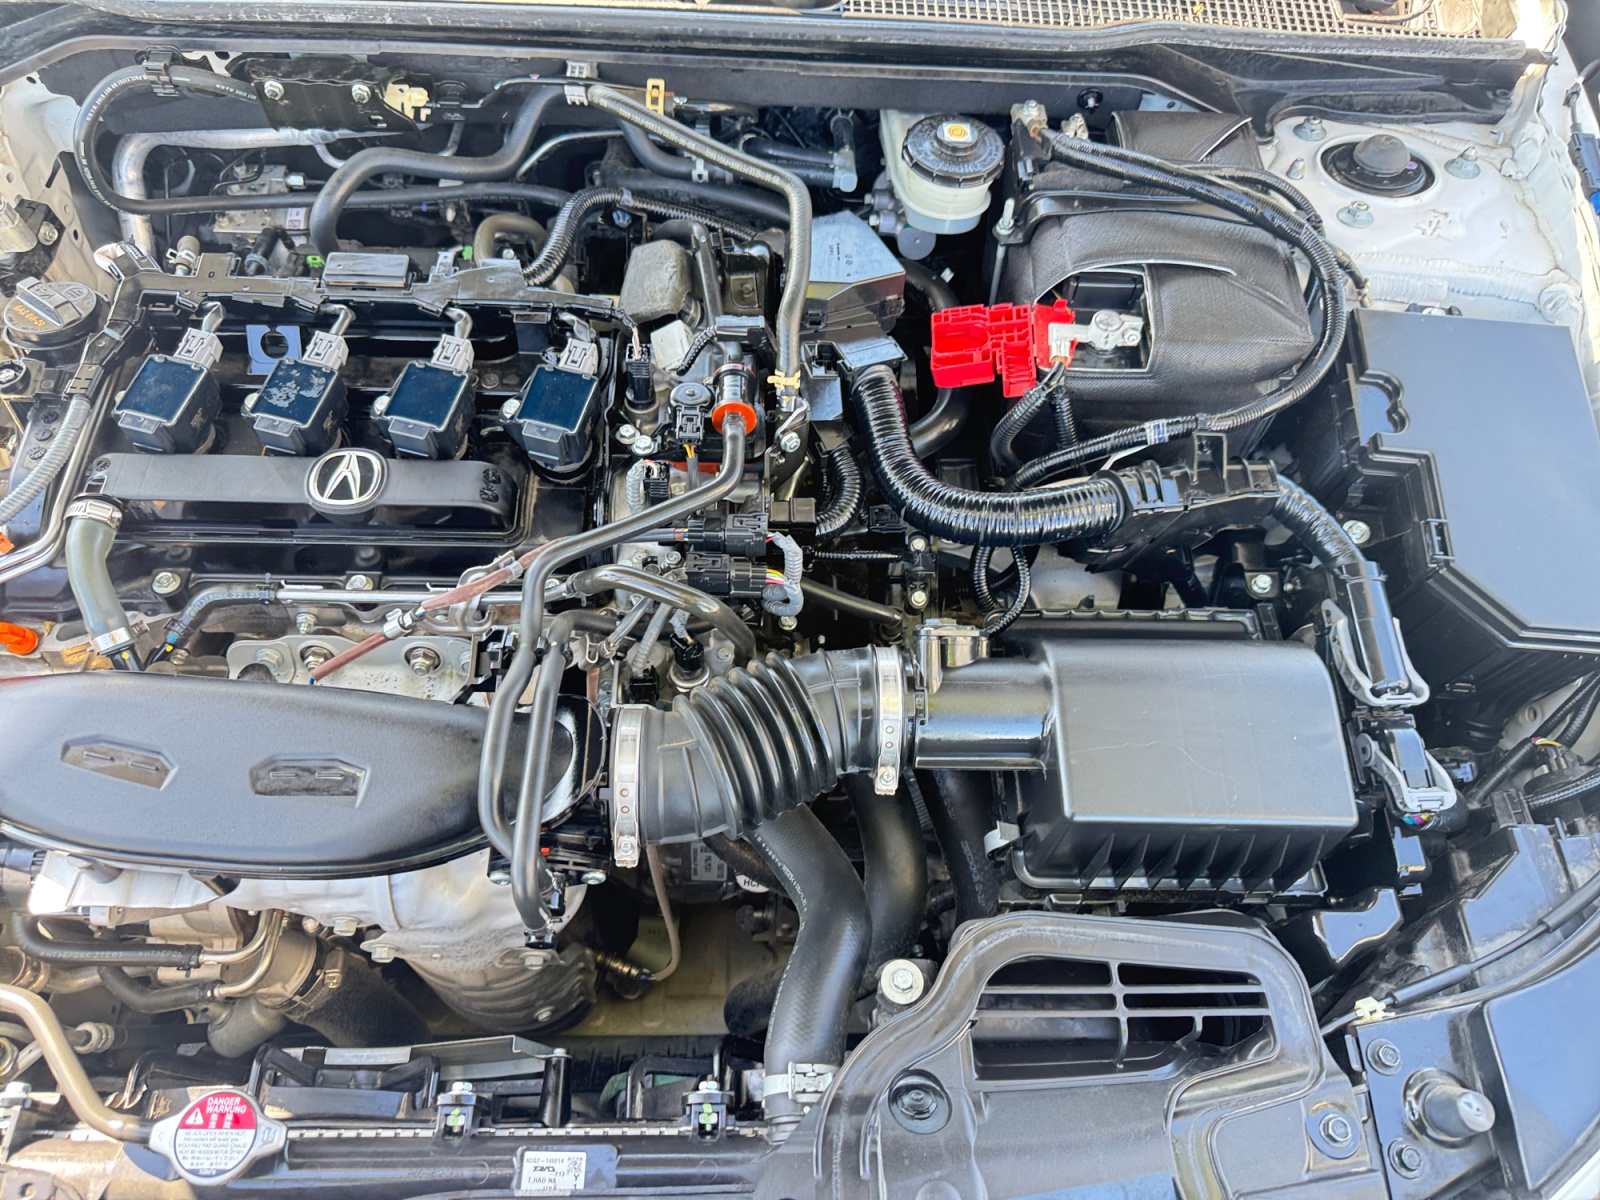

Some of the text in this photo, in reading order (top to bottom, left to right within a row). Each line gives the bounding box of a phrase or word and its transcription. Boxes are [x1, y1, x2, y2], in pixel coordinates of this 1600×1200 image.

[743, 878, 760, 888] HC
[207, 1096, 241, 1105] DANGER
[206, 1105, 247, 1114] WARNUNG
[573, 1174, 580, 1182] Y
